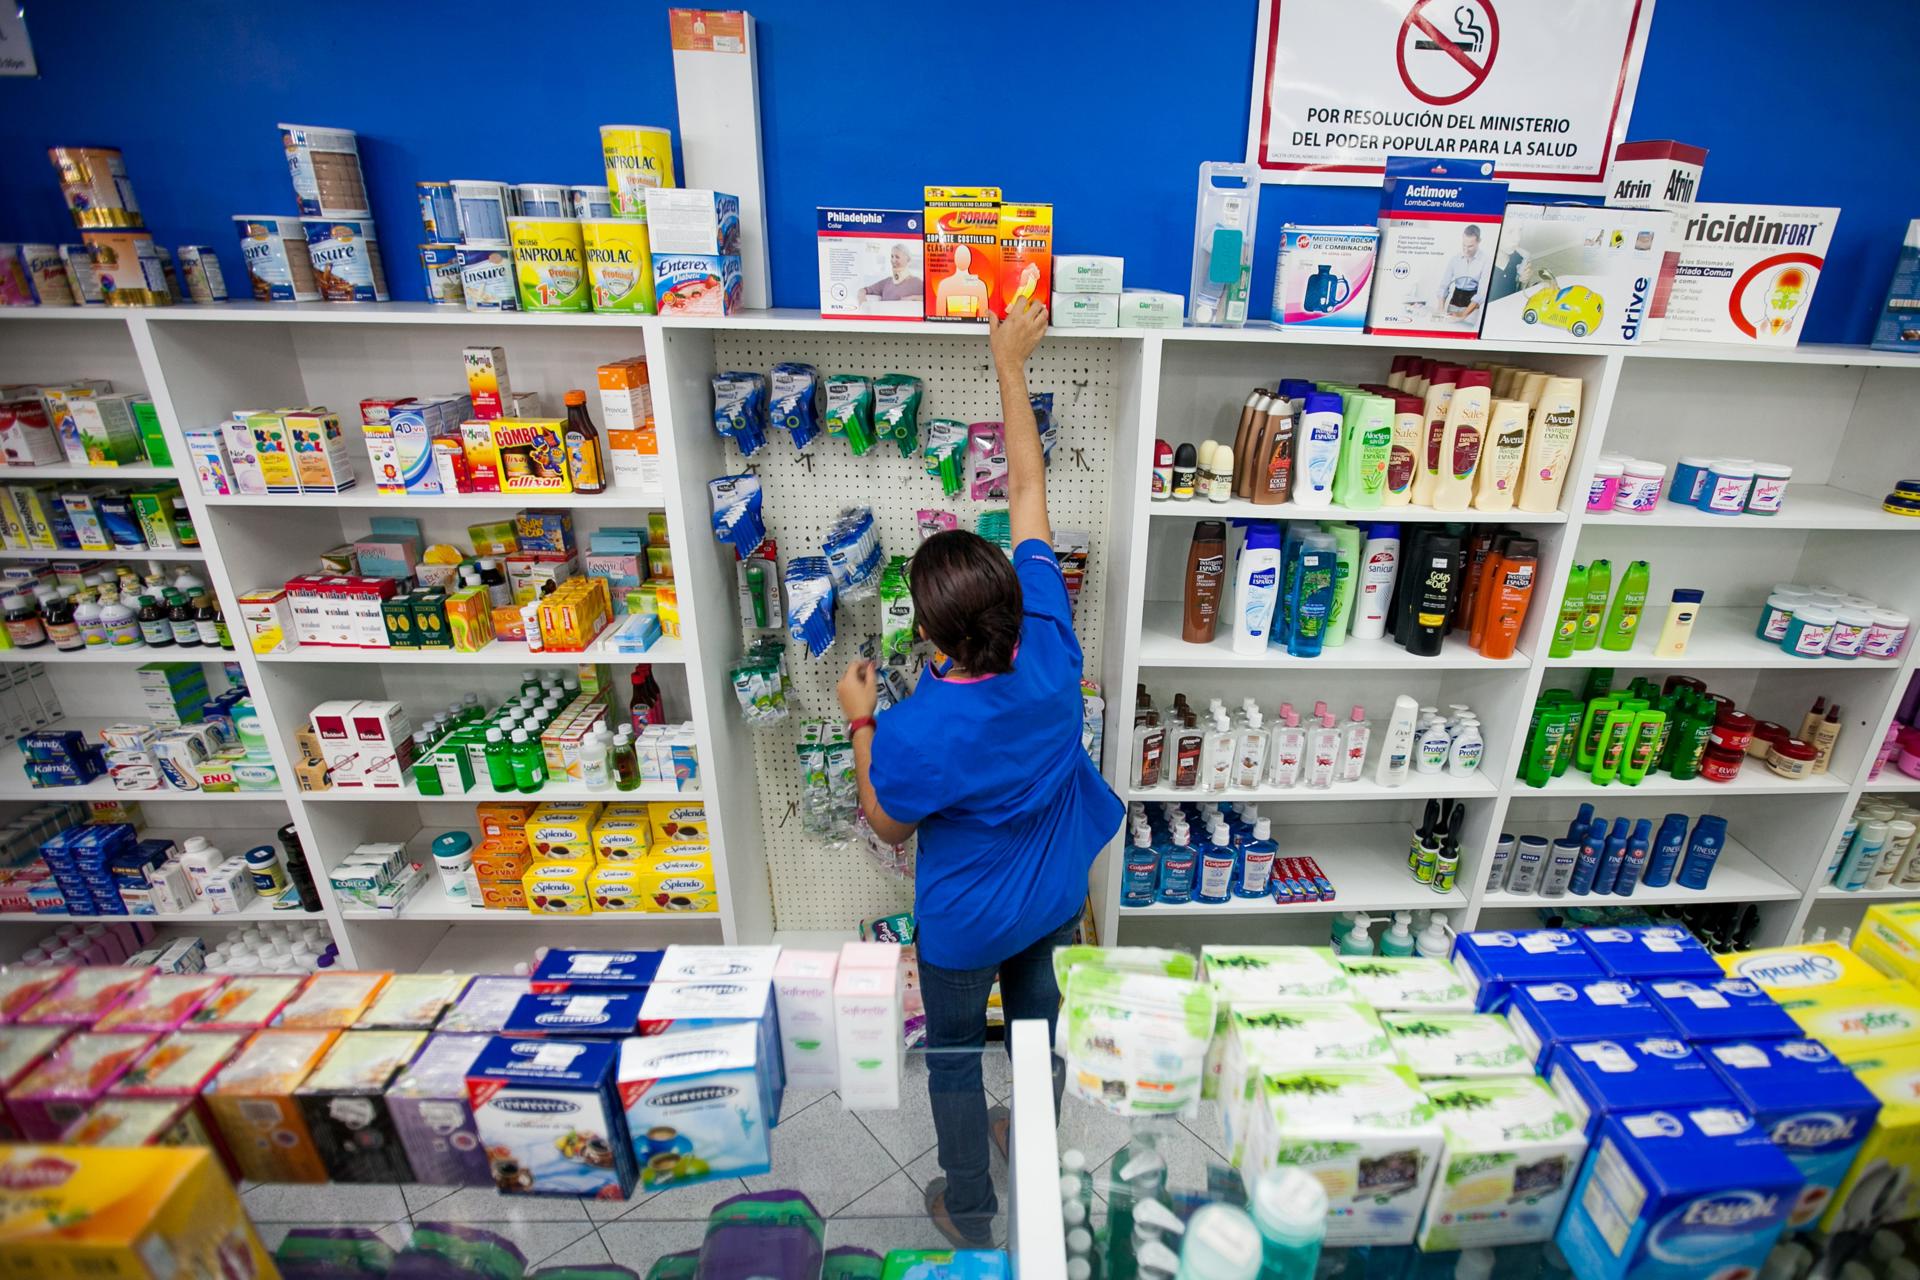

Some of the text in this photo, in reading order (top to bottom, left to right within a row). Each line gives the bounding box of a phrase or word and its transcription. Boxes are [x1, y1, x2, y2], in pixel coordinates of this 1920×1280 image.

[1307, 107, 1571, 134] POR RESOLUCIÓN DEL MINISTERIO
[1292, 131, 1578, 157] DEL PODER POPULAR PARA LA SALUD
[1405, 184, 1458, 199] Actimove
[1614, 180, 1652, 199] Afrin
[1664, 168, 1694, 204] Afrin
[1404, 199, 1465, 209] LombaCare-Motion
[827, 212, 882, 224] Philadelphia
[957, 211, 998, 225] FORMA
[957, 235, 995, 244] COSTILLERO
[656, 260, 708, 278] Enterex
[1703, 268, 1731, 277] Común
[464, 266, 506, 285] Ensure
[1621, 276, 1649, 341] drive
[1462, 409, 1485, 418] Sales
[1545, 414, 1575, 425] Avena
[1499, 434, 1524, 444] Avena
[509, 477, 560, 488] allixon
[1368, 564, 1394, 573] sanicur
[1430, 571, 1451, 582] Gotas
[1423, 745, 1446, 754] Protex
[1458, 748, 1480, 757] Protex
[203, 773, 232, 785] ENO
[538, 829, 573, 841] Splenda
[602, 836, 633, 845] Splenda
[1693, 846, 1717, 854] FINESSE
[1166, 861, 1192, 869] Colgate
[534, 882, 571, 893] Splenda
[597, 885, 628, 894] Splenda
[662, 880, 700, 891] Splenda
[1751, 955, 1837, 983] Splenda
